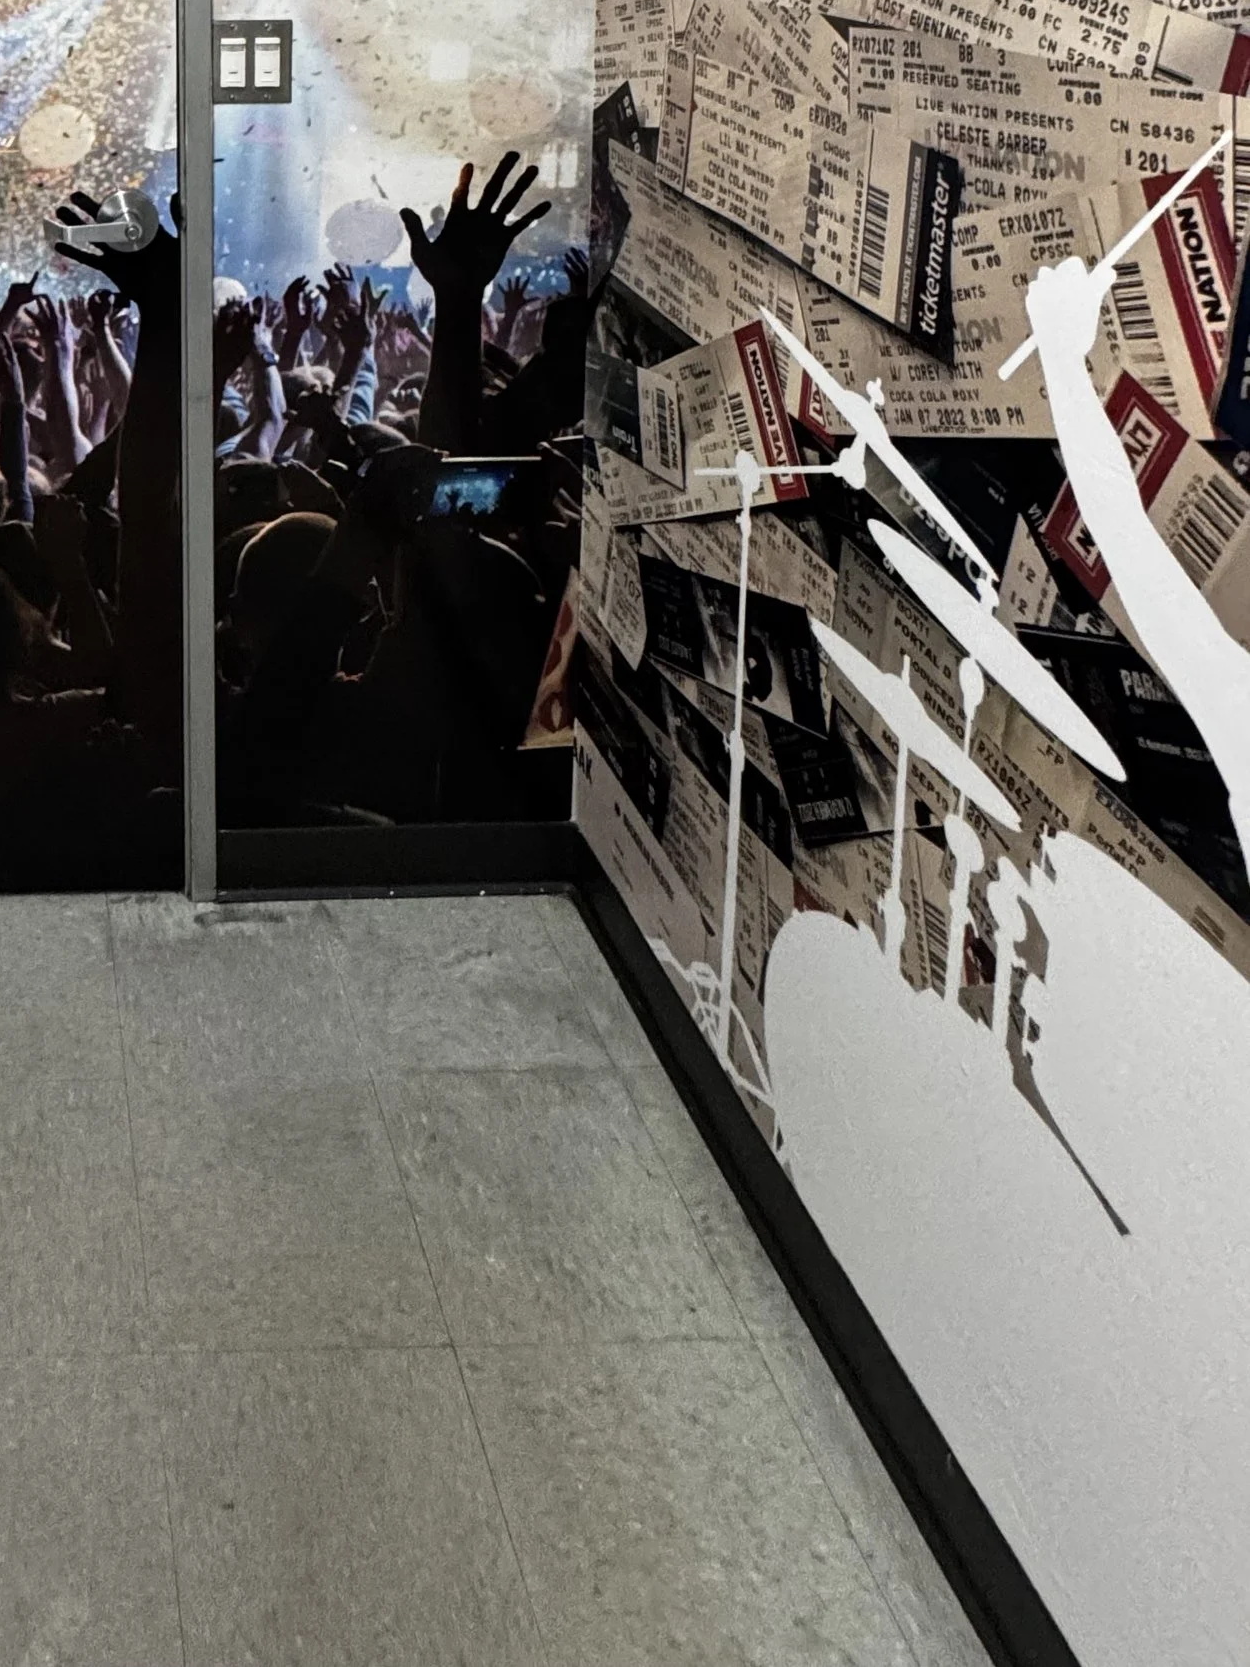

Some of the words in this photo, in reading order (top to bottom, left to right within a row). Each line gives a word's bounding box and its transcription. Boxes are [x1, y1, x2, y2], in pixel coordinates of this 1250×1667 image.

[1042, 11, 1063, 32] FC
[902, 39, 923, 59] 201
[901, 69, 960, 90] RESERVED
[965, 76, 1023, 96] SEATING
[1064, 90, 1103, 106] 0.00
[915, 97, 945, 112] LIVE
[950, 102, 1000, 122] NATION
[1005, 108, 1076, 132] PRESENTS
[1110, 119, 1130, 134] CN
[936, 120, 992, 148] CELESTE
[995, 130, 1049, 157] BARBER
[1137, 152, 1168, 174] 201
[918, 170, 952, 336] ticketmaster
[1174, 205, 1228, 325] NATION
[749, 348, 778, 427] NATION
[908, 363, 948, 383] COREY
[888, 387, 917, 404] COCA
[919, 387, 949, 403] COLA
[952, 387, 982, 403] ROXY
[893, 407, 916, 427] JAN
[937, 407, 968, 426] 2022
[969, 407, 1003, 426] 8:00
[1005, 407, 1025, 426] PM
[893, 616, 941, 673] PORTAL
[922, 689, 966, 739] RINGO
